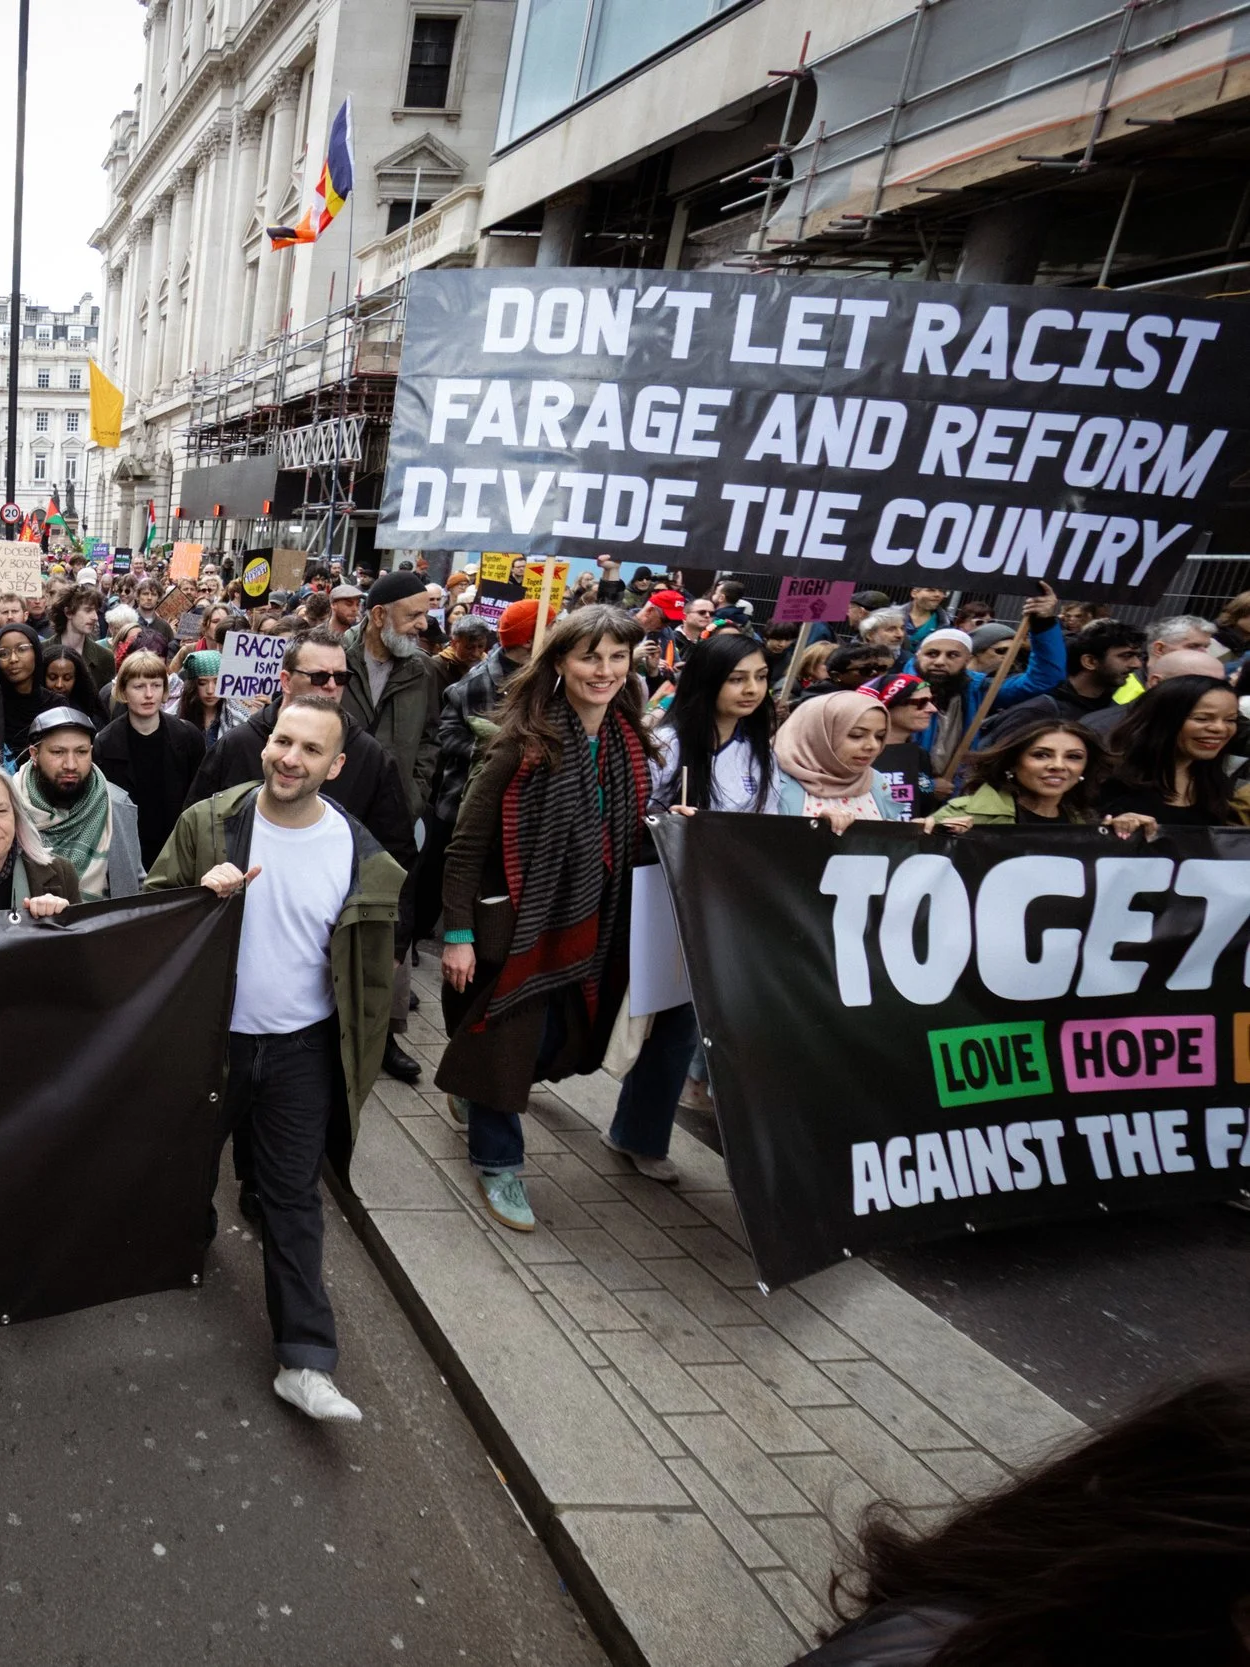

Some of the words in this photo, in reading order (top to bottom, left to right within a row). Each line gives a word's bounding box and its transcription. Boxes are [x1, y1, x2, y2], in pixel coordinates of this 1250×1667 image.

[482, 285, 712, 359] DON'T
[728, 294, 889, 369] LET
[902, 302, 1221, 394] RACIST
[428, 379, 733, 459] FARAGE
[745, 393, 909, 471] AND
[917, 404, 1229, 500] REFORM
[4, 508, 18, 518] 20
[397, 466, 698, 551] DIVIDE
[718, 483, 866, 562] THE
[871, 497, 1193, 588] COUNTRY
[7, 580, 38, 592] JETS
[16, 571, 33, 581] BY
[481, 596, 495, 606] WE
[788, 579, 833, 596] RIGHT
[818, 853, 1250, 1007] TOGET
[939, 1033, 1040, 1093] LOVE
[1072, 1027, 1203, 1079] HOPE
[851, 1119, 1067, 1216] AGAINST
[1075, 1109, 1195, 1180] THE
